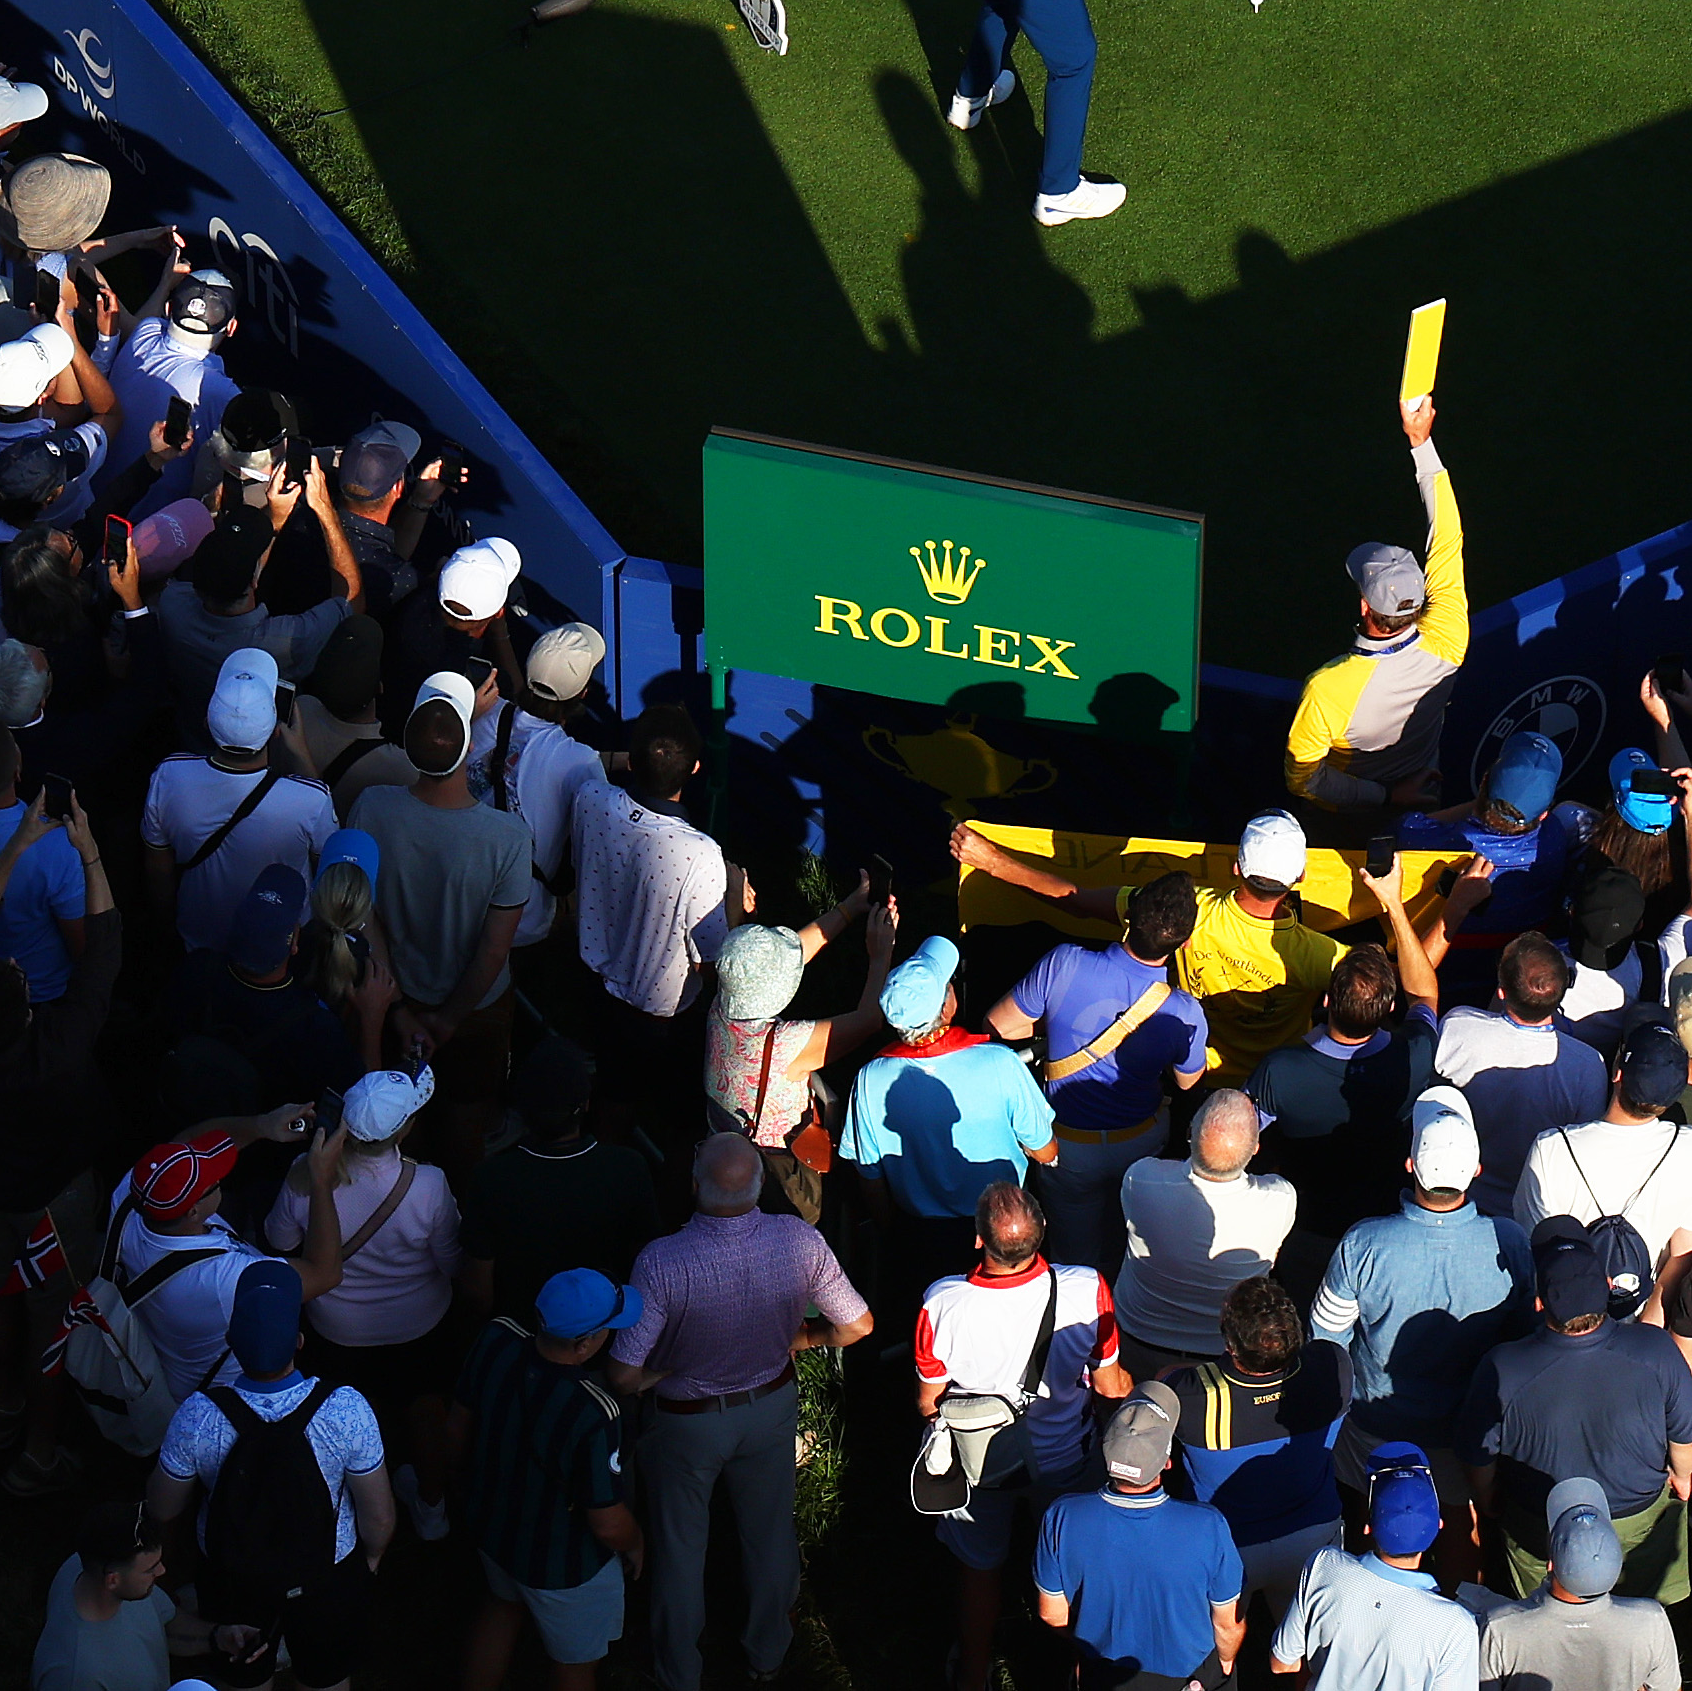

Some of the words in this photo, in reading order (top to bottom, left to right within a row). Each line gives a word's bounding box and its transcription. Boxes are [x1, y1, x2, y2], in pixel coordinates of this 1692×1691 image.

[53, 56, 79, 97] DP
[79, 87, 147, 176] WORLD
[814, 594, 1080, 680] ROLEX
[1492, 682, 1588, 740] BMW
[1253, 1391, 1282, 1406] EUROP
